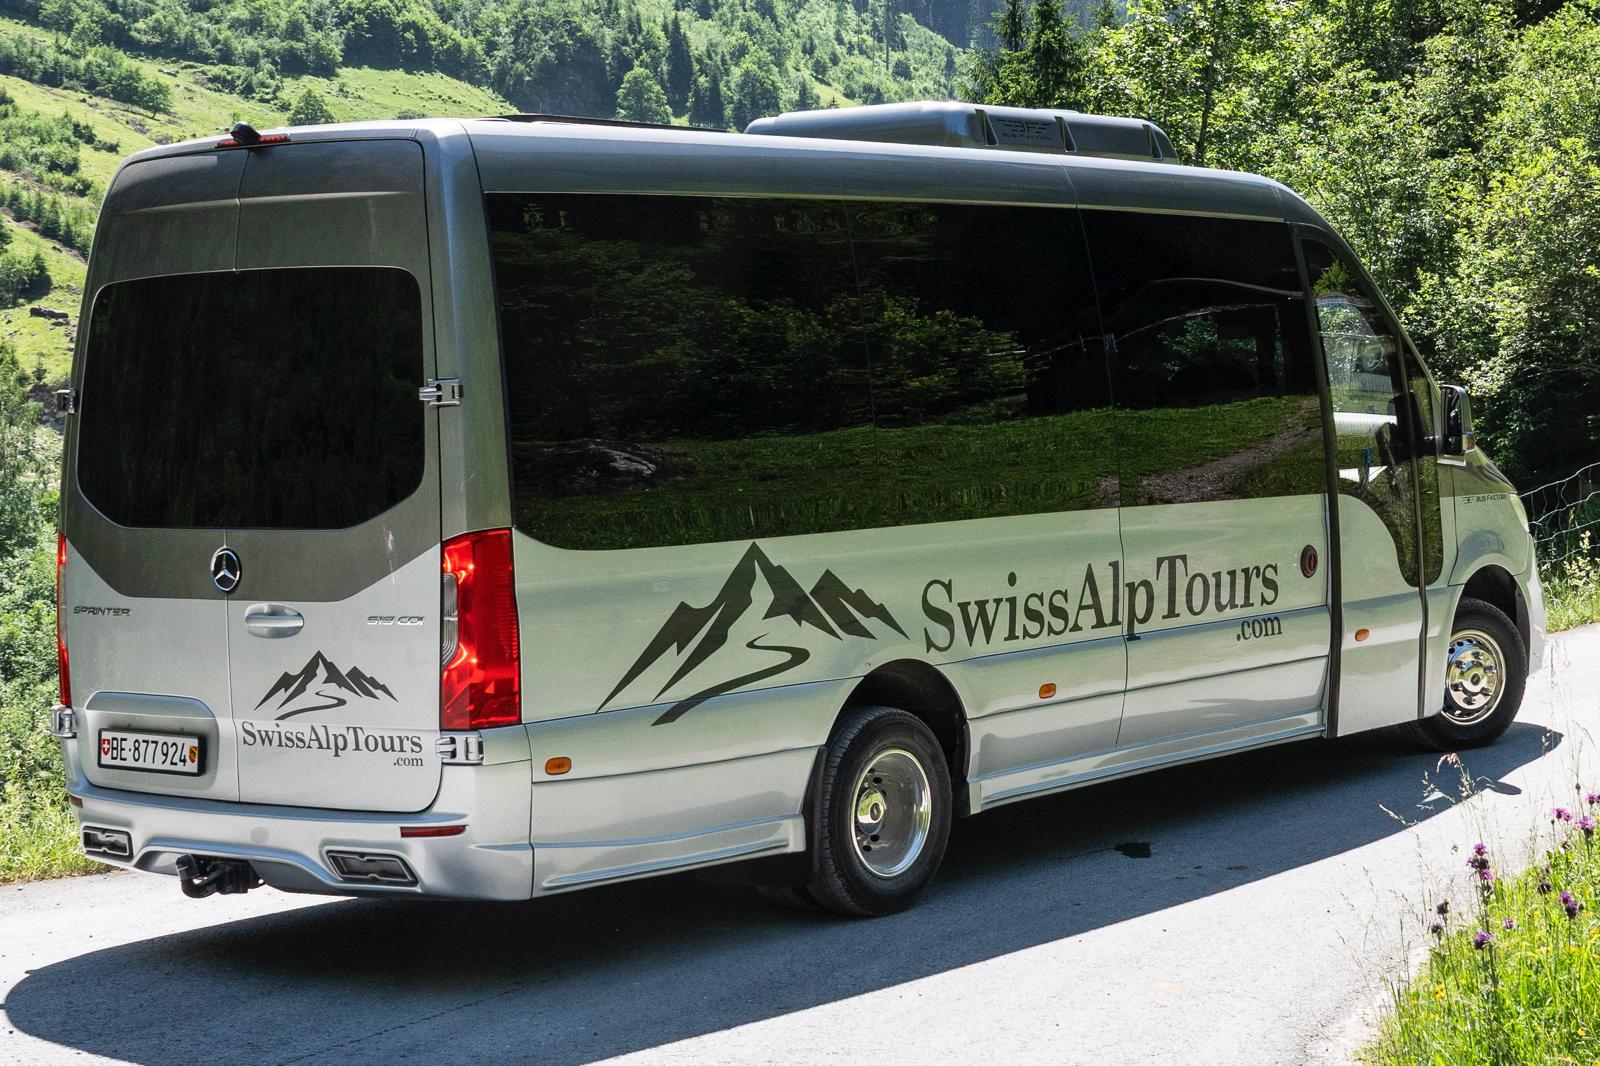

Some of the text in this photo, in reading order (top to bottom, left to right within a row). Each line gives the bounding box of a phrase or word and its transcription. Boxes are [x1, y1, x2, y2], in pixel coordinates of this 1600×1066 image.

[73, 606, 131, 617] SPRINTER
[921, 553, 1280, 654] SwissAlpTours
[397, 615, 425, 625] CDI
[1235, 614, 1282, 642] .com
[241, 720, 423, 758] SwissAlpTours
[393, 755, 424, 767] .com
